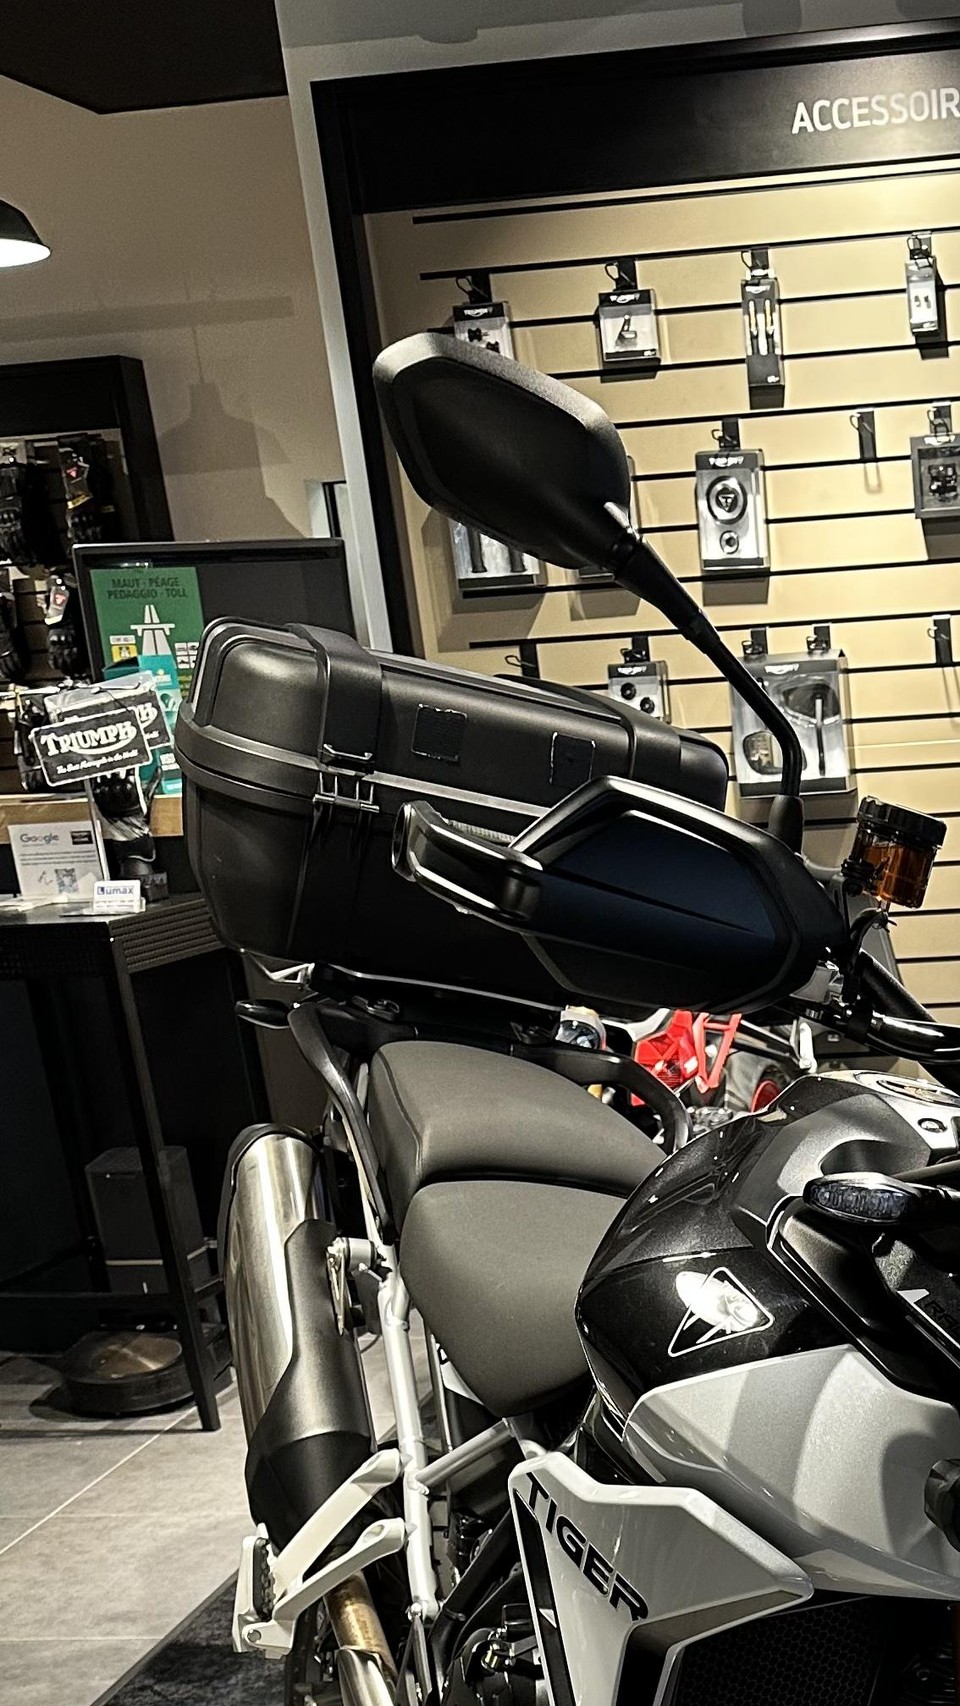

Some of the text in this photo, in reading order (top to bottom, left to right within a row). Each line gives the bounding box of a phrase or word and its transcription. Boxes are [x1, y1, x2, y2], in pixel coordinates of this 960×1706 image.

[111, 578, 139, 588] MAUT
[107, 587, 187, 599] PEDAGGIO TOLL
[40, 721, 137, 756] TRIUMPH
[20, 833, 59, 844] Google
[525, 1471, 649, 1622] TIGER
